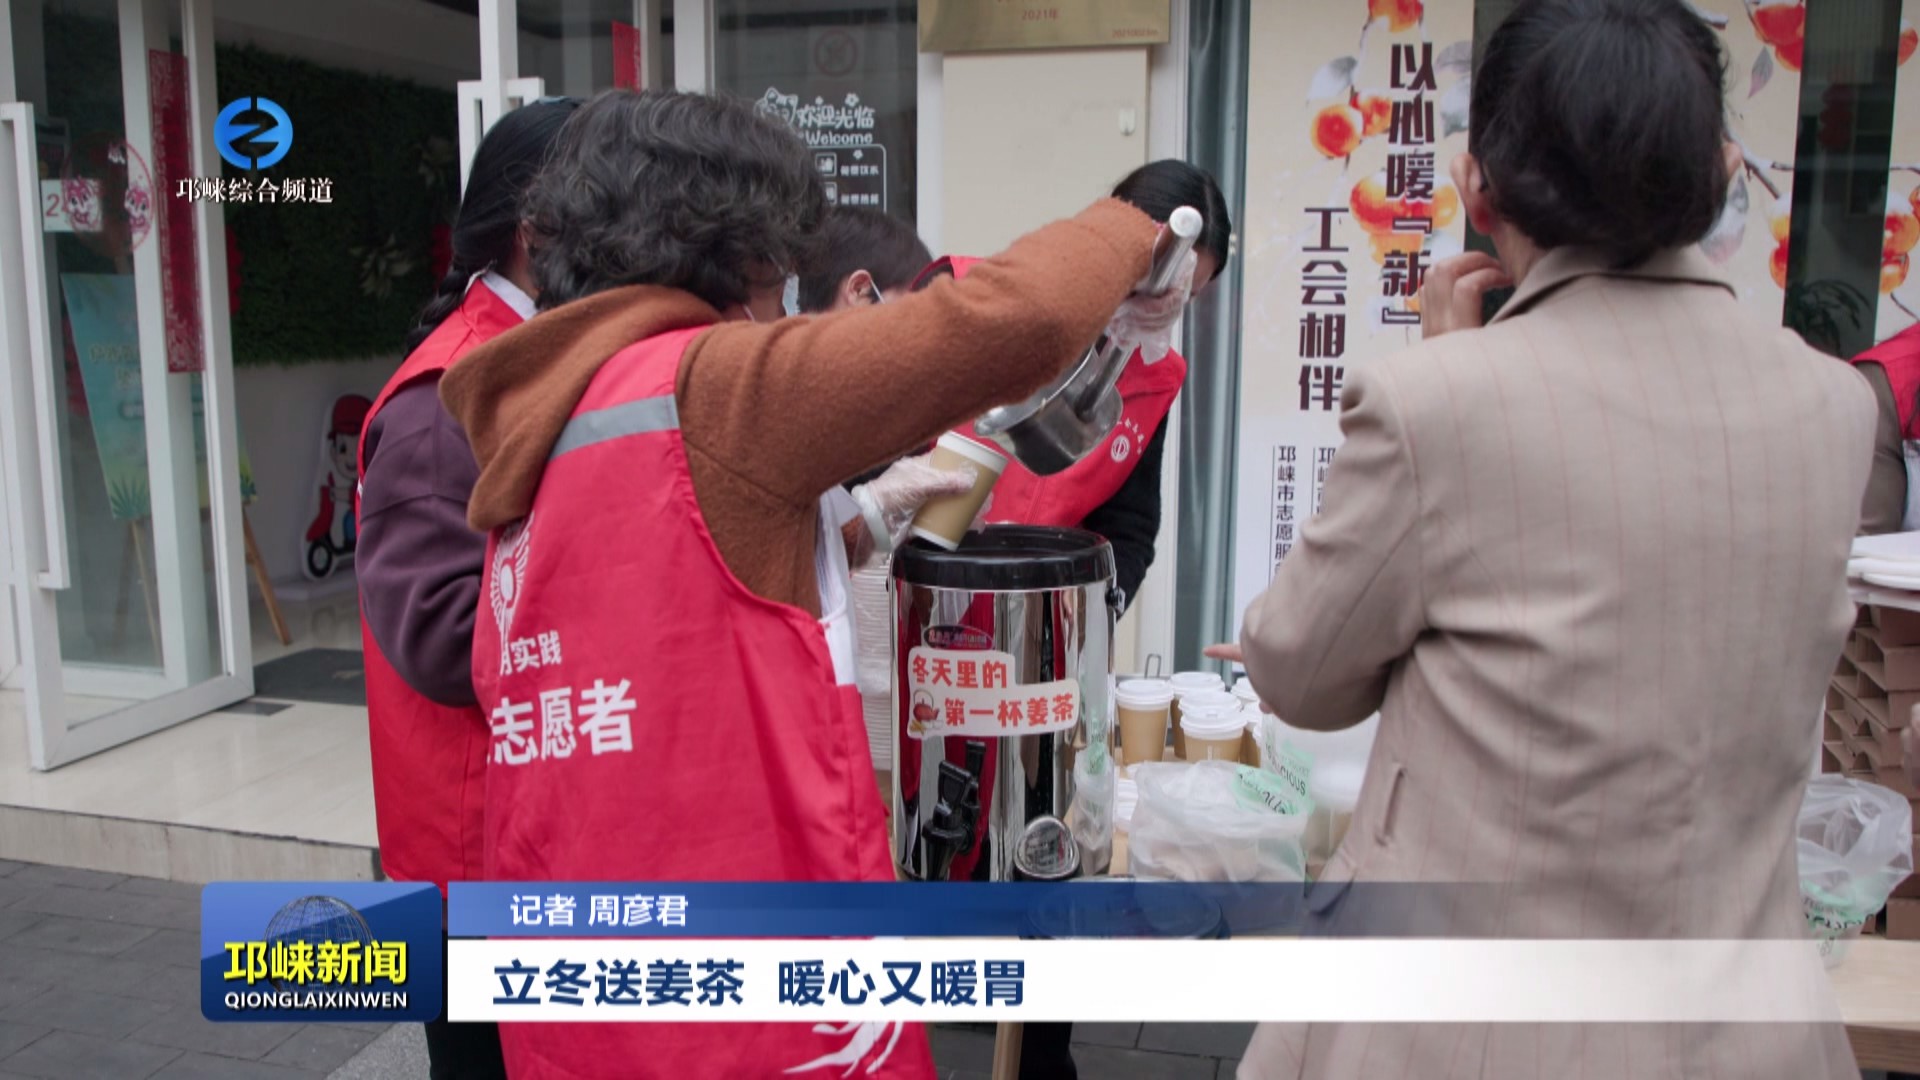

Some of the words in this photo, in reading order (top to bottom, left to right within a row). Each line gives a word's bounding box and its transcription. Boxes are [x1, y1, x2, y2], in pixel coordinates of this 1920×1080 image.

[797, 102, 876, 129] 欢迎光临
[805, 130, 873, 145] Welcome
[1299, 207, 1350, 412] 工会相伴
[1274, 445, 1297, 574] 邛崃市志愿服
[912, 655, 1007, 689] 冬天里的
[944, 693, 1074, 728] 第一杯姜茶
